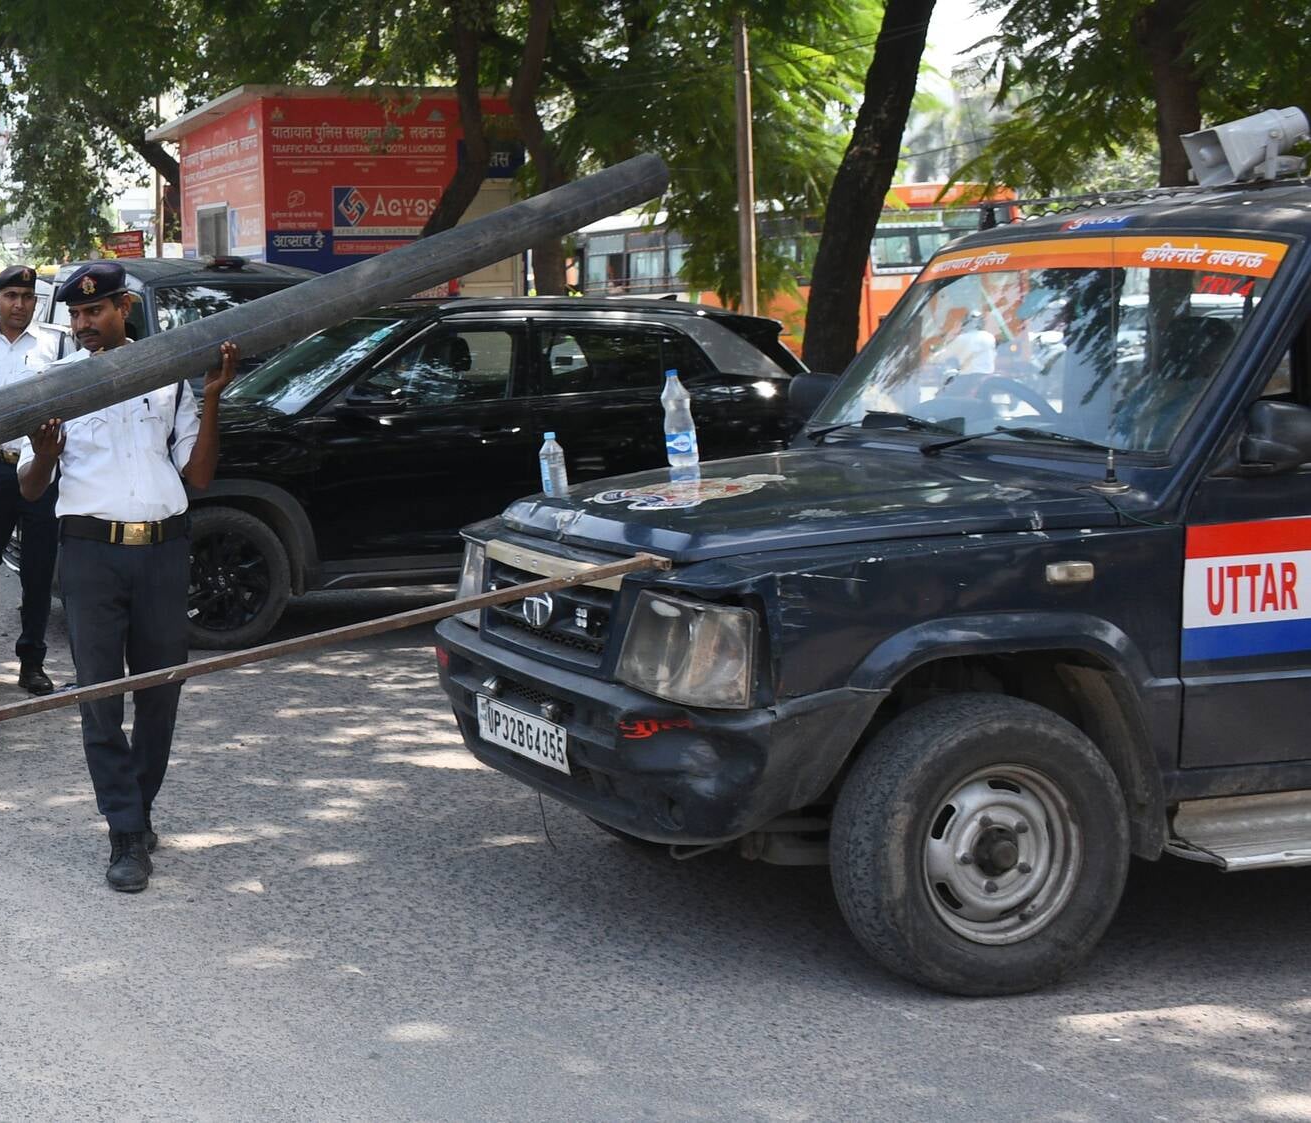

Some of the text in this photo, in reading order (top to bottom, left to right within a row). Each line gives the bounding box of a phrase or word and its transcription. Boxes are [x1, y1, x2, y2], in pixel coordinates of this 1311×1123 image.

[315, 122, 342, 143] पुलिस
[409, 126, 445, 138] लखनऊ
[272, 144, 303, 152] TRAFFIC
[305, 144, 331, 152] POLICE
[409, 144, 446, 152] LUCKNOW
[1207, 250, 1267, 268] लखनऊ
[1206, 562, 1298, 616] UTTAR
[488, 707, 564, 765] UP32BG4355
